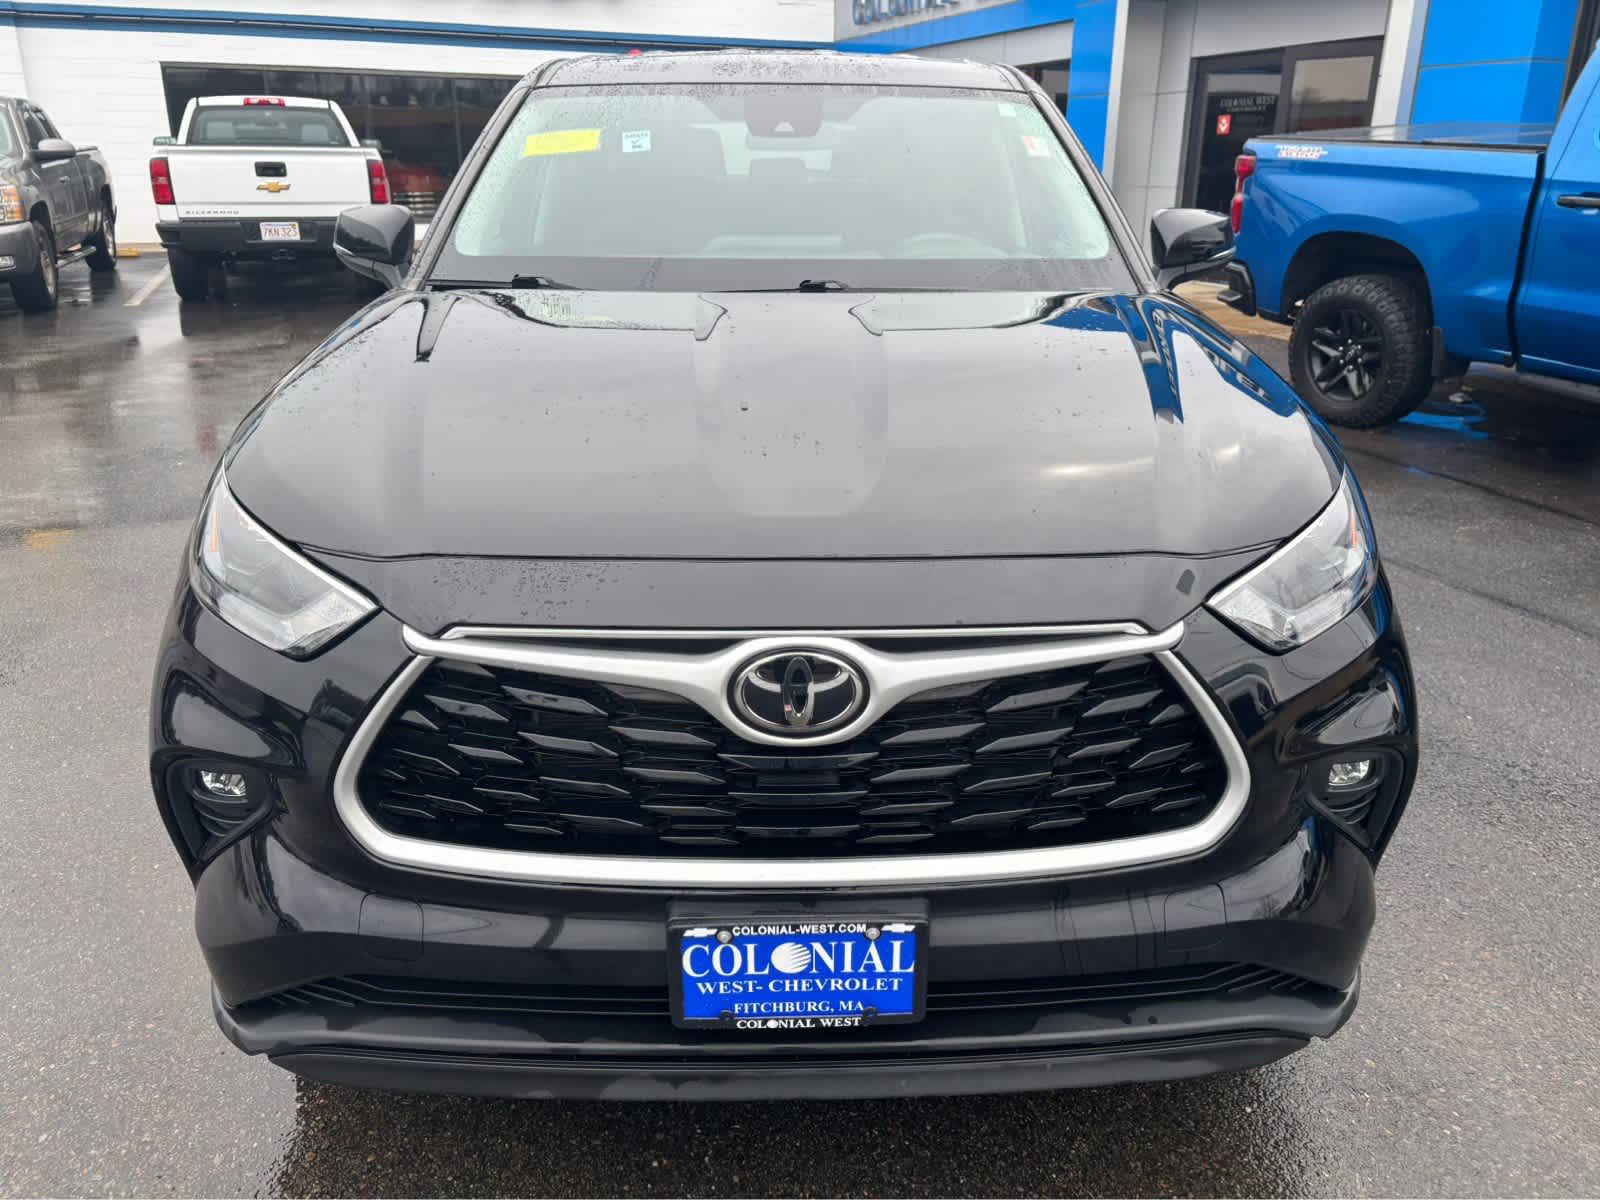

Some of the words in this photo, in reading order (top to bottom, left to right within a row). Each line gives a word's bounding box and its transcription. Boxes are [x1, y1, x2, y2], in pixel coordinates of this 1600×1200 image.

[732, 924, 867, 936] COLONIAL-WEST.COM
[682, 941, 915, 977] COLONIAL
[768, 977, 904, 993] CHEVROLET
[734, 1001, 835, 1014] FITCHBURG,
[839, 1000, 864, 1012] MA
[736, 1018, 815, 1030] COLONIAL
[820, 1016, 862, 1027] WEST
